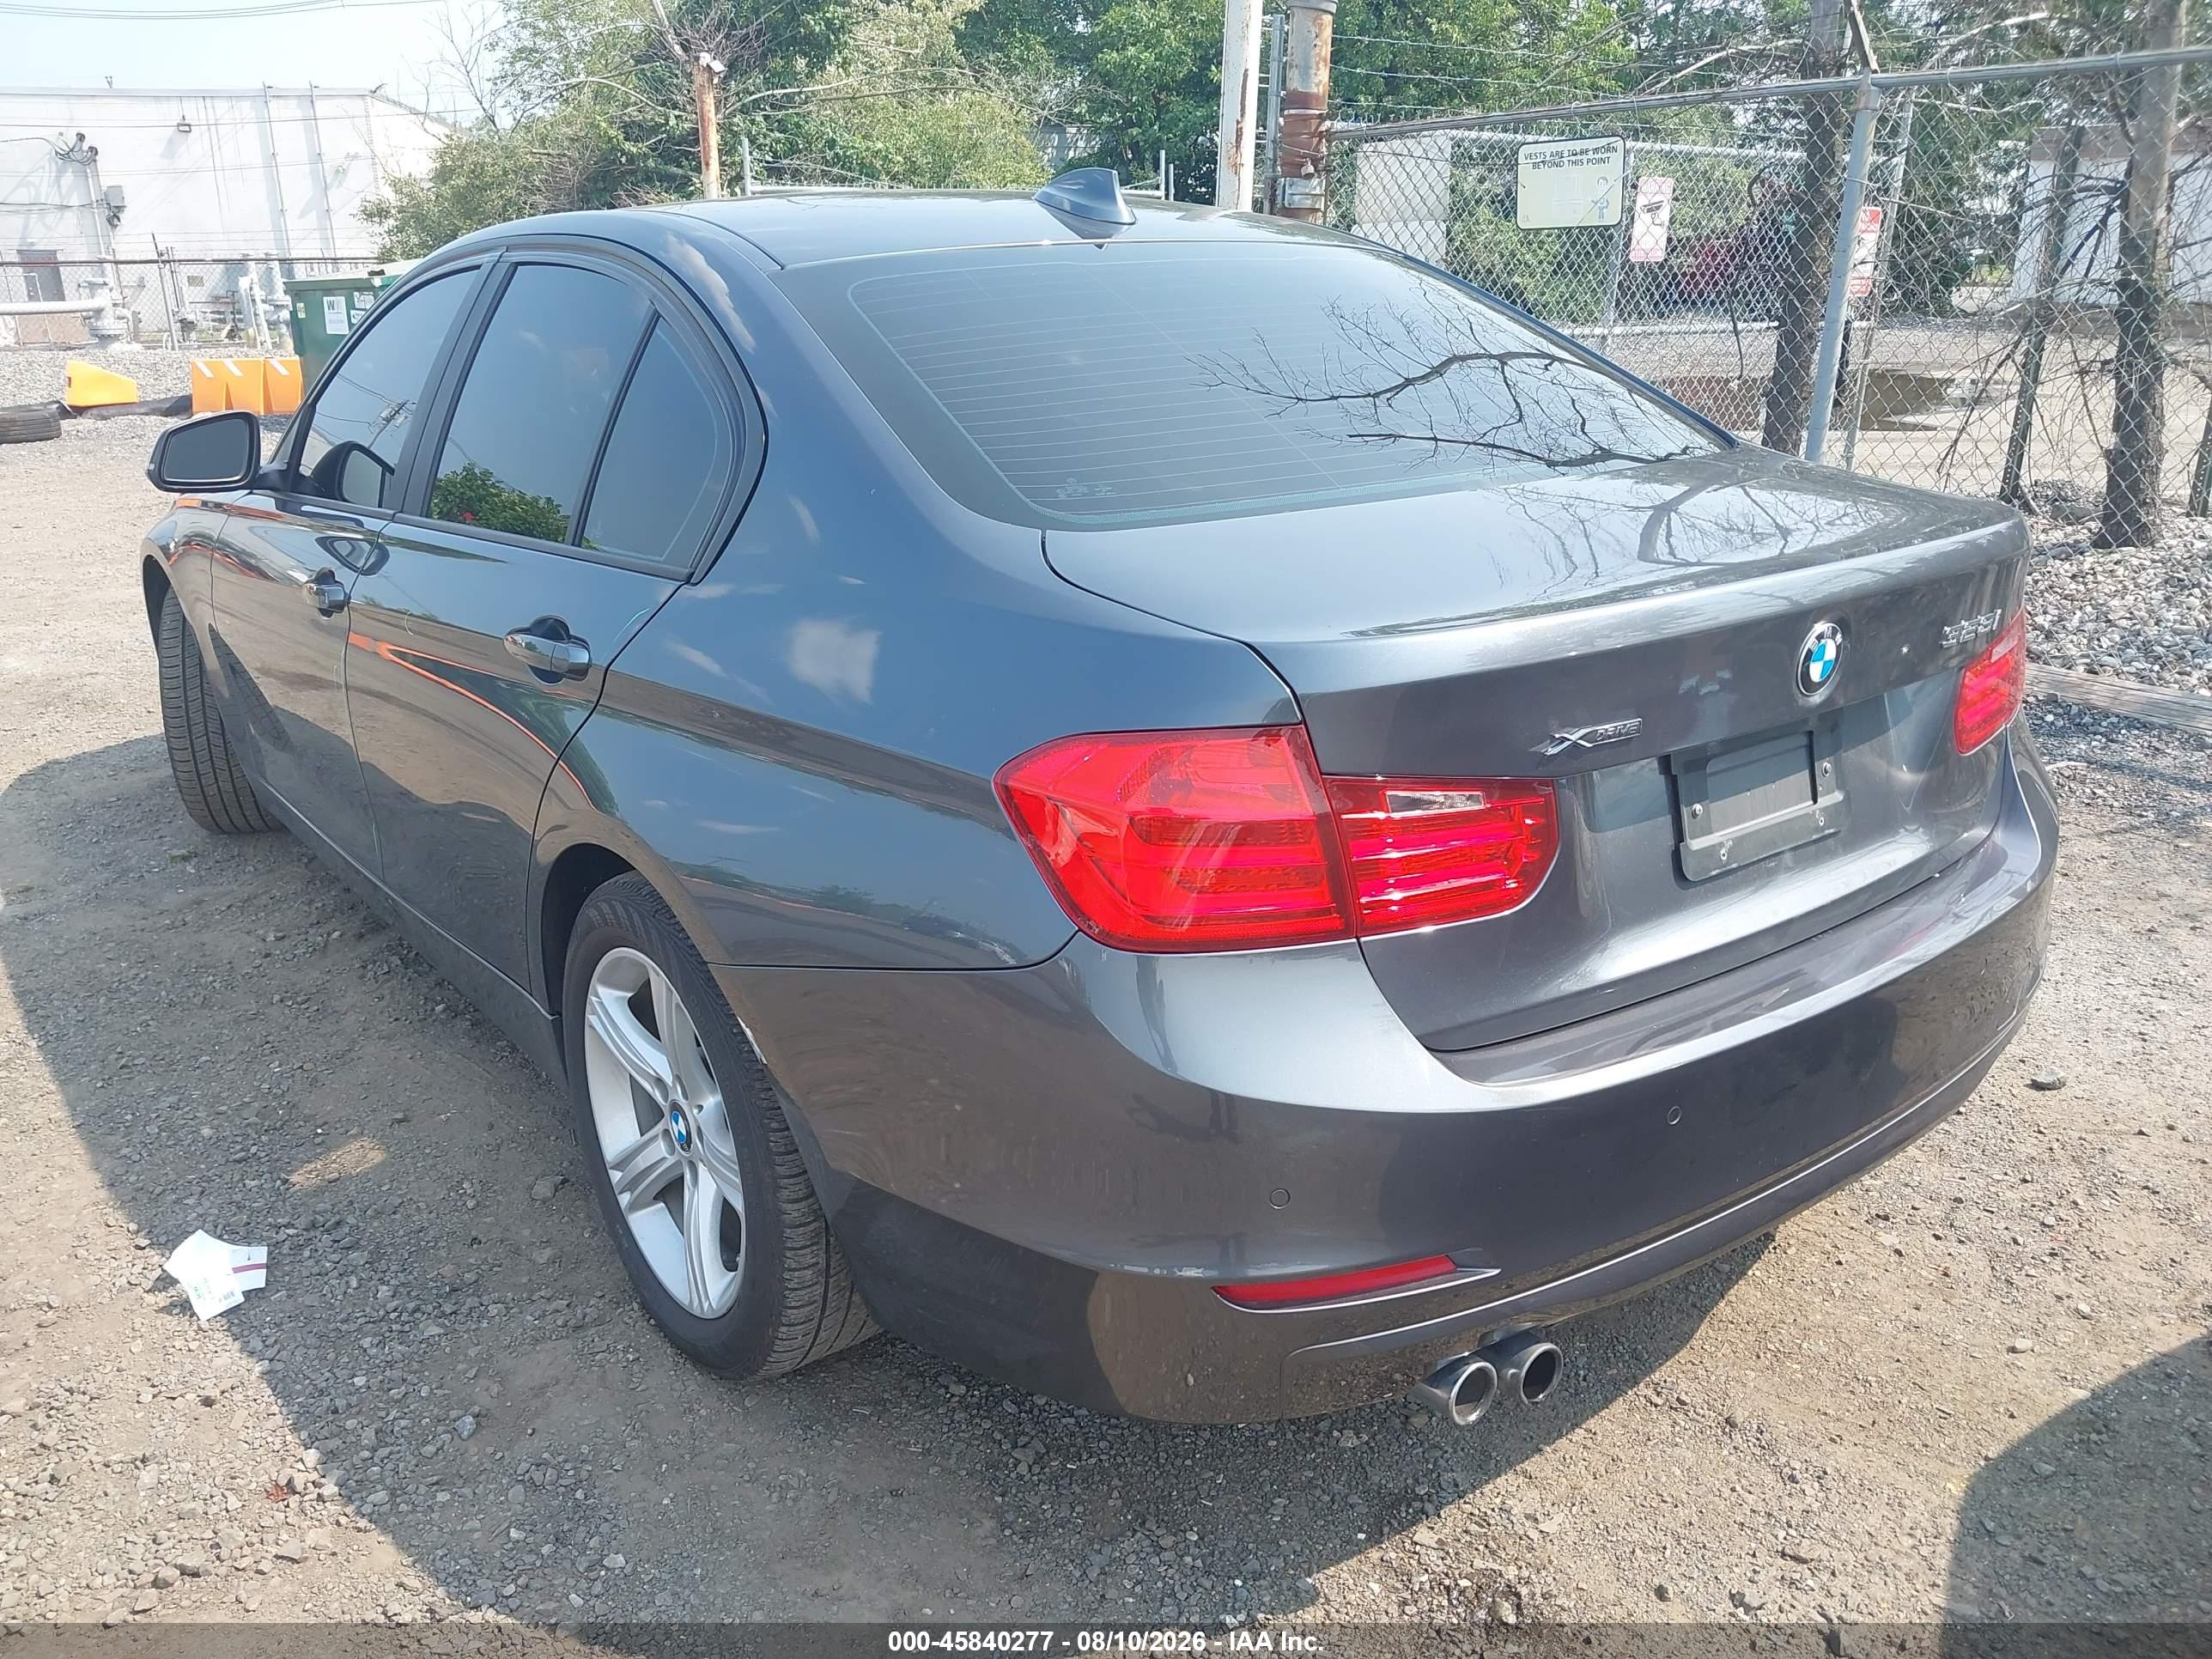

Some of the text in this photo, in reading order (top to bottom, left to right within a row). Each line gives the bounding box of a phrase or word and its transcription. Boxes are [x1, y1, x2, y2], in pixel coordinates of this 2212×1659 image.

[1523, 145, 1618, 161] VESTS ARE TO BE WORN
[1532, 156, 1611, 170] BEYOND THIS POINT
